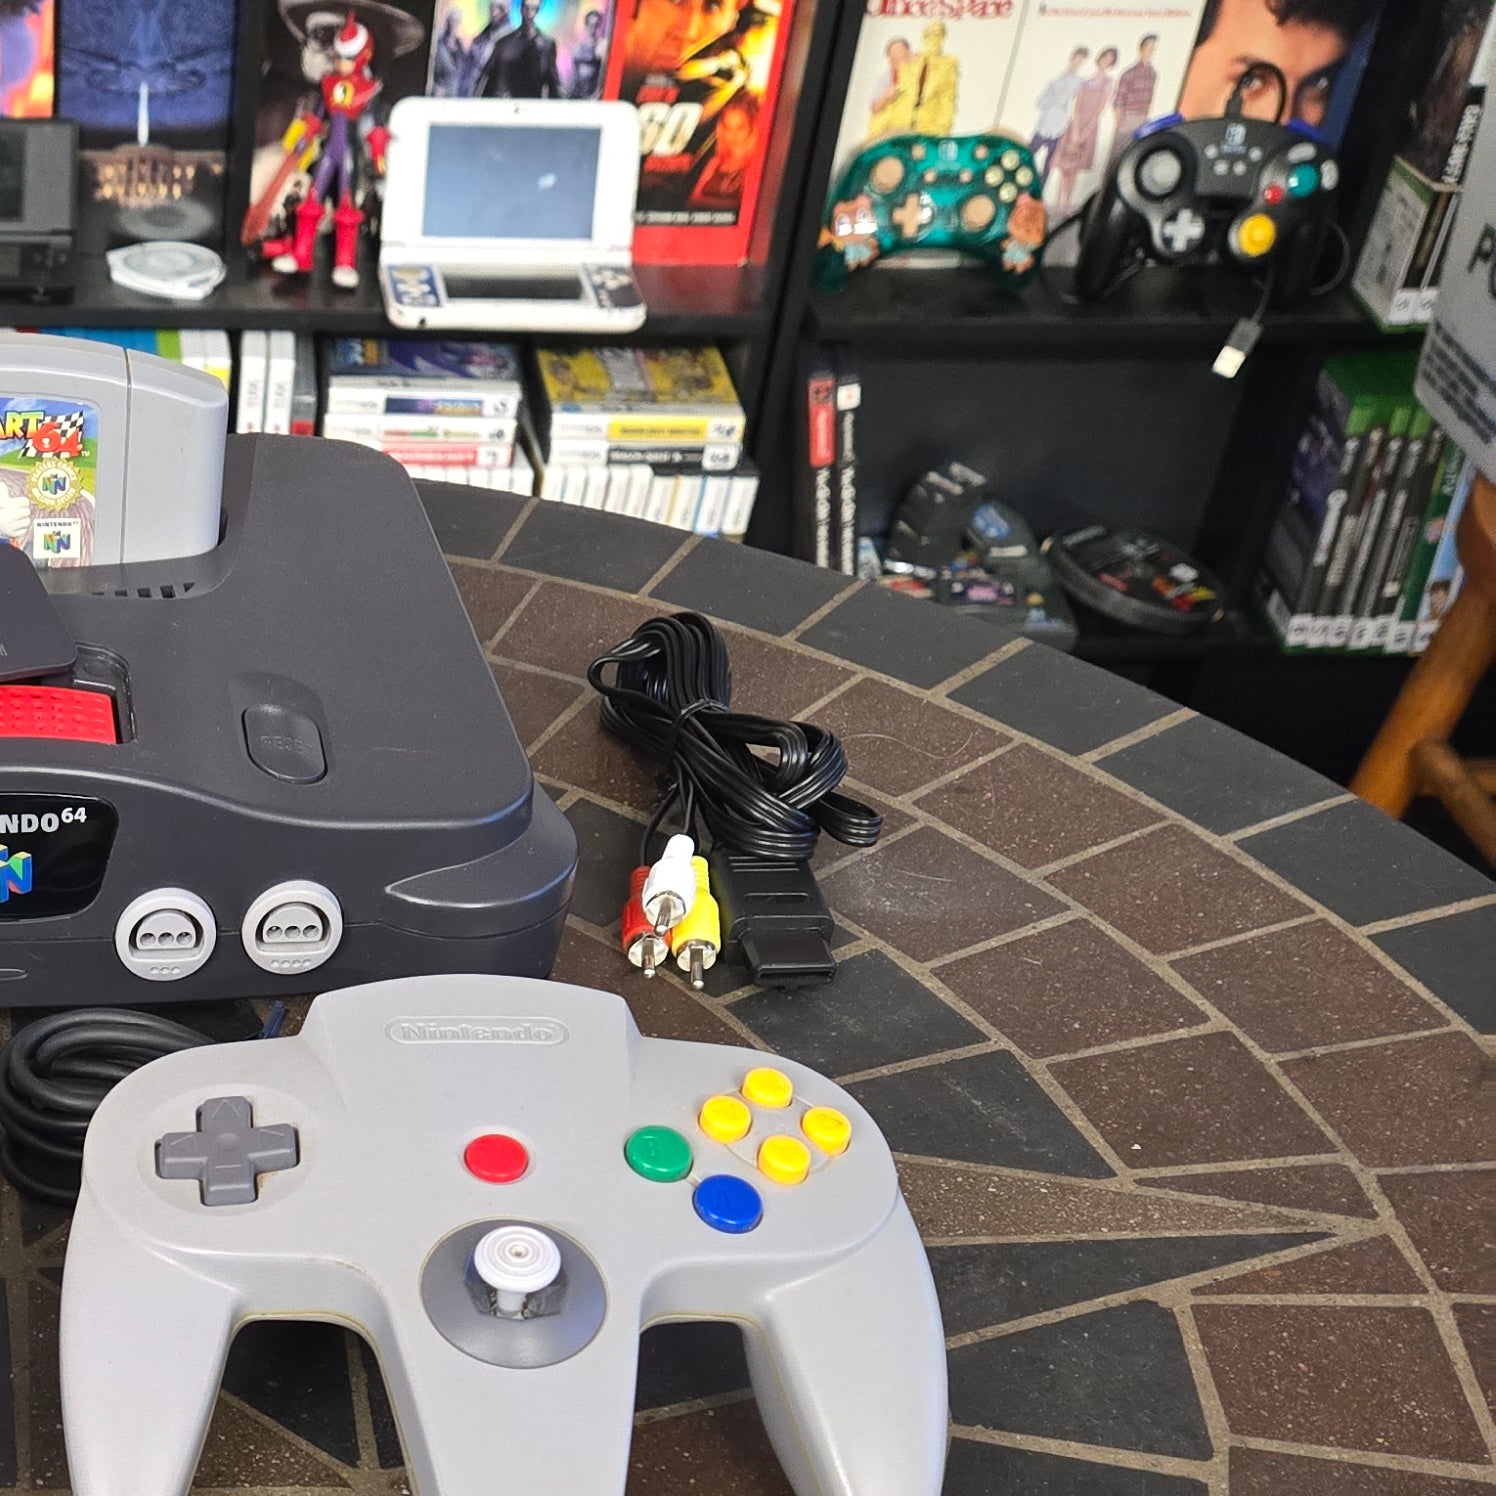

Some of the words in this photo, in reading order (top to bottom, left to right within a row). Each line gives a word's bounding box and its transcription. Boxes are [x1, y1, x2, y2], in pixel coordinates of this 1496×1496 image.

[29, 421, 83, 456] 64
[61, 807, 88, 823] 64
[401, 1022, 553, 1041] Nintendo
